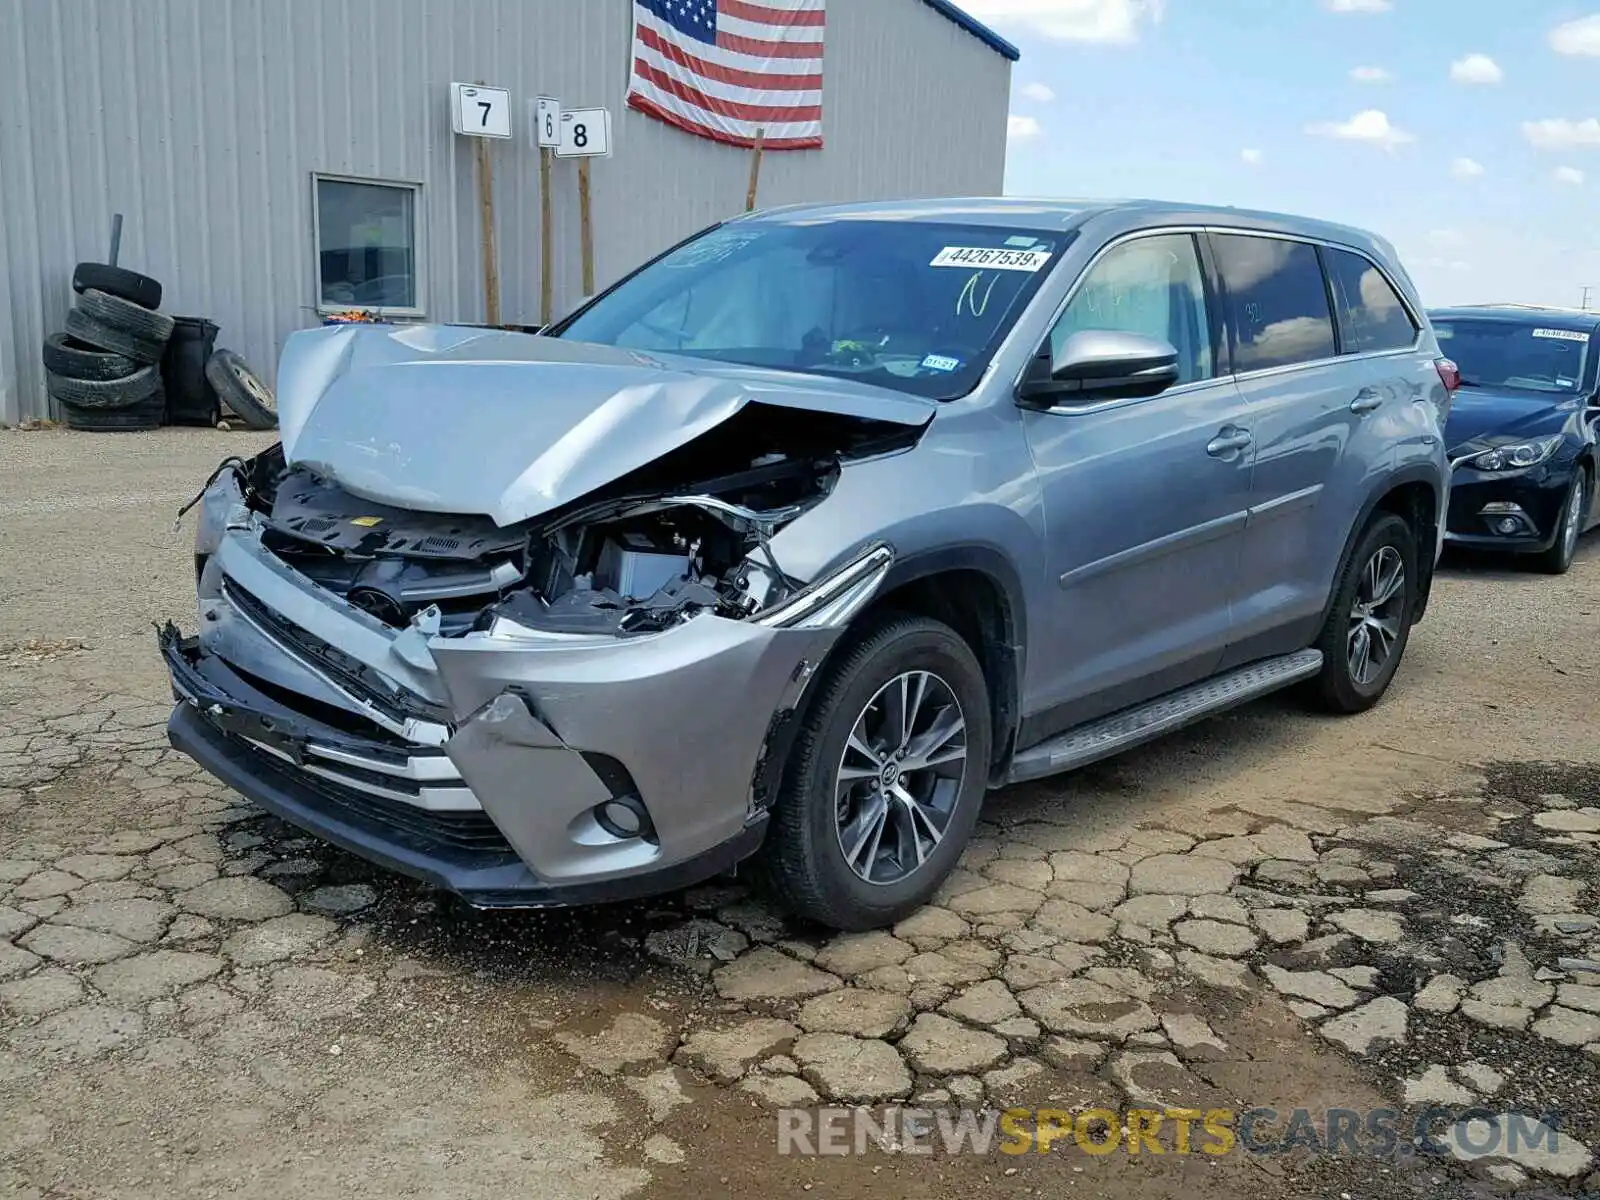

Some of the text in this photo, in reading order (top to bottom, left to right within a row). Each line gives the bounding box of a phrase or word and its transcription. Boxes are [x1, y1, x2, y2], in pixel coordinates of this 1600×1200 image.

[477, 101, 492, 127] 7
[545, 113, 553, 138] 6
[573, 123, 588, 148] 8
[949, 248, 1035, 266] 44267539
